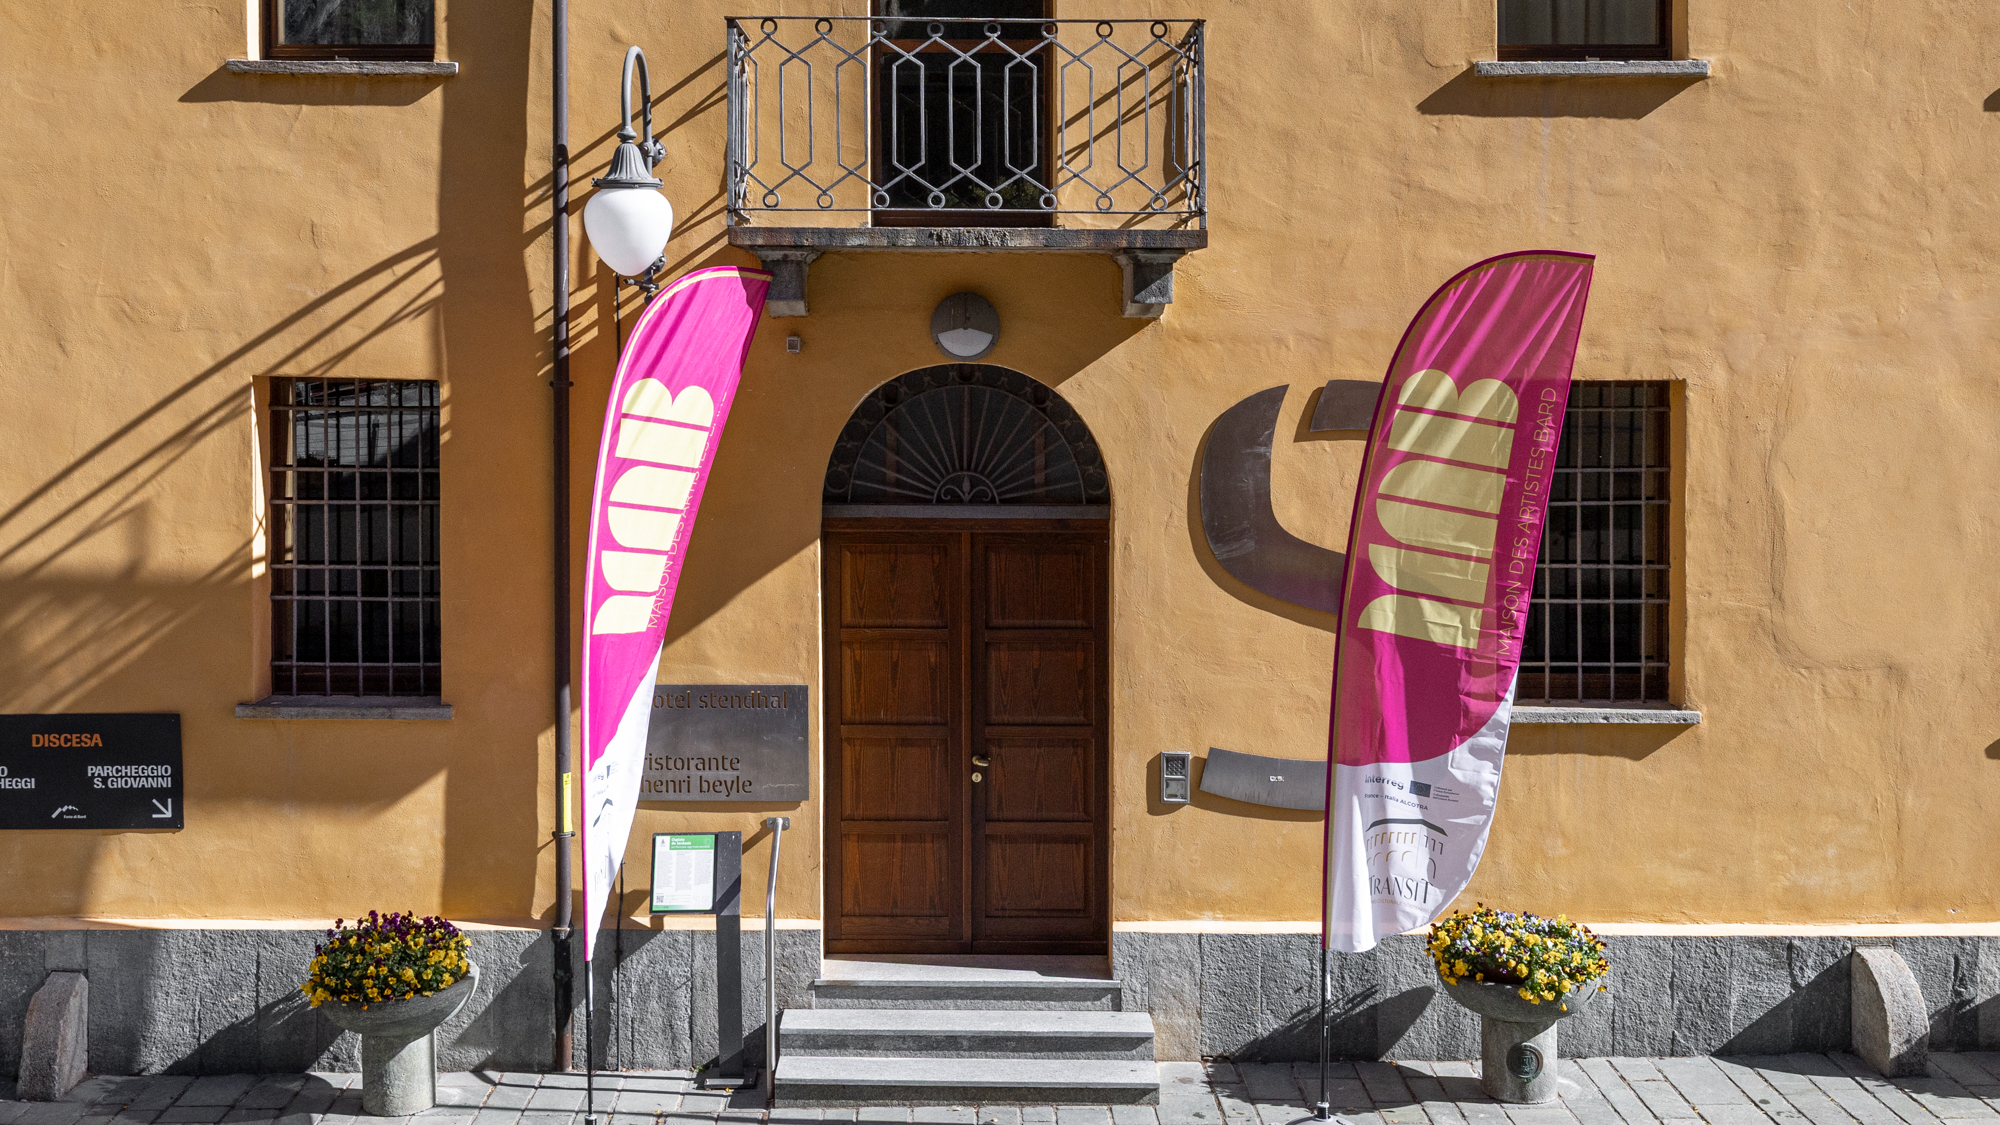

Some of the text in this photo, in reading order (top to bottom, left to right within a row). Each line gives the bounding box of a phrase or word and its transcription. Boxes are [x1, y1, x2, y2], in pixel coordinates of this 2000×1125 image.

[1496, 387, 1557, 656] MAISON DES ARTISTES BARD
[647, 560, 674, 628] MAISON
[668, 521, 685, 555] DES
[652, 690, 788, 709] otel stendhal
[31, 733, 103, 748] DISCESA
[87, 765, 172, 777] PARCHEGGIO
[644, 753, 741, 771] istorante
[93, 777, 172, 789] S. GIOVANNI
[699, 776, 753, 798] beyle
[1365, 775, 1404, 791] Interreg
[1399, 799, 1429, 811] ALCOTRA
[1369, 874, 1434, 904] TRANSIT
